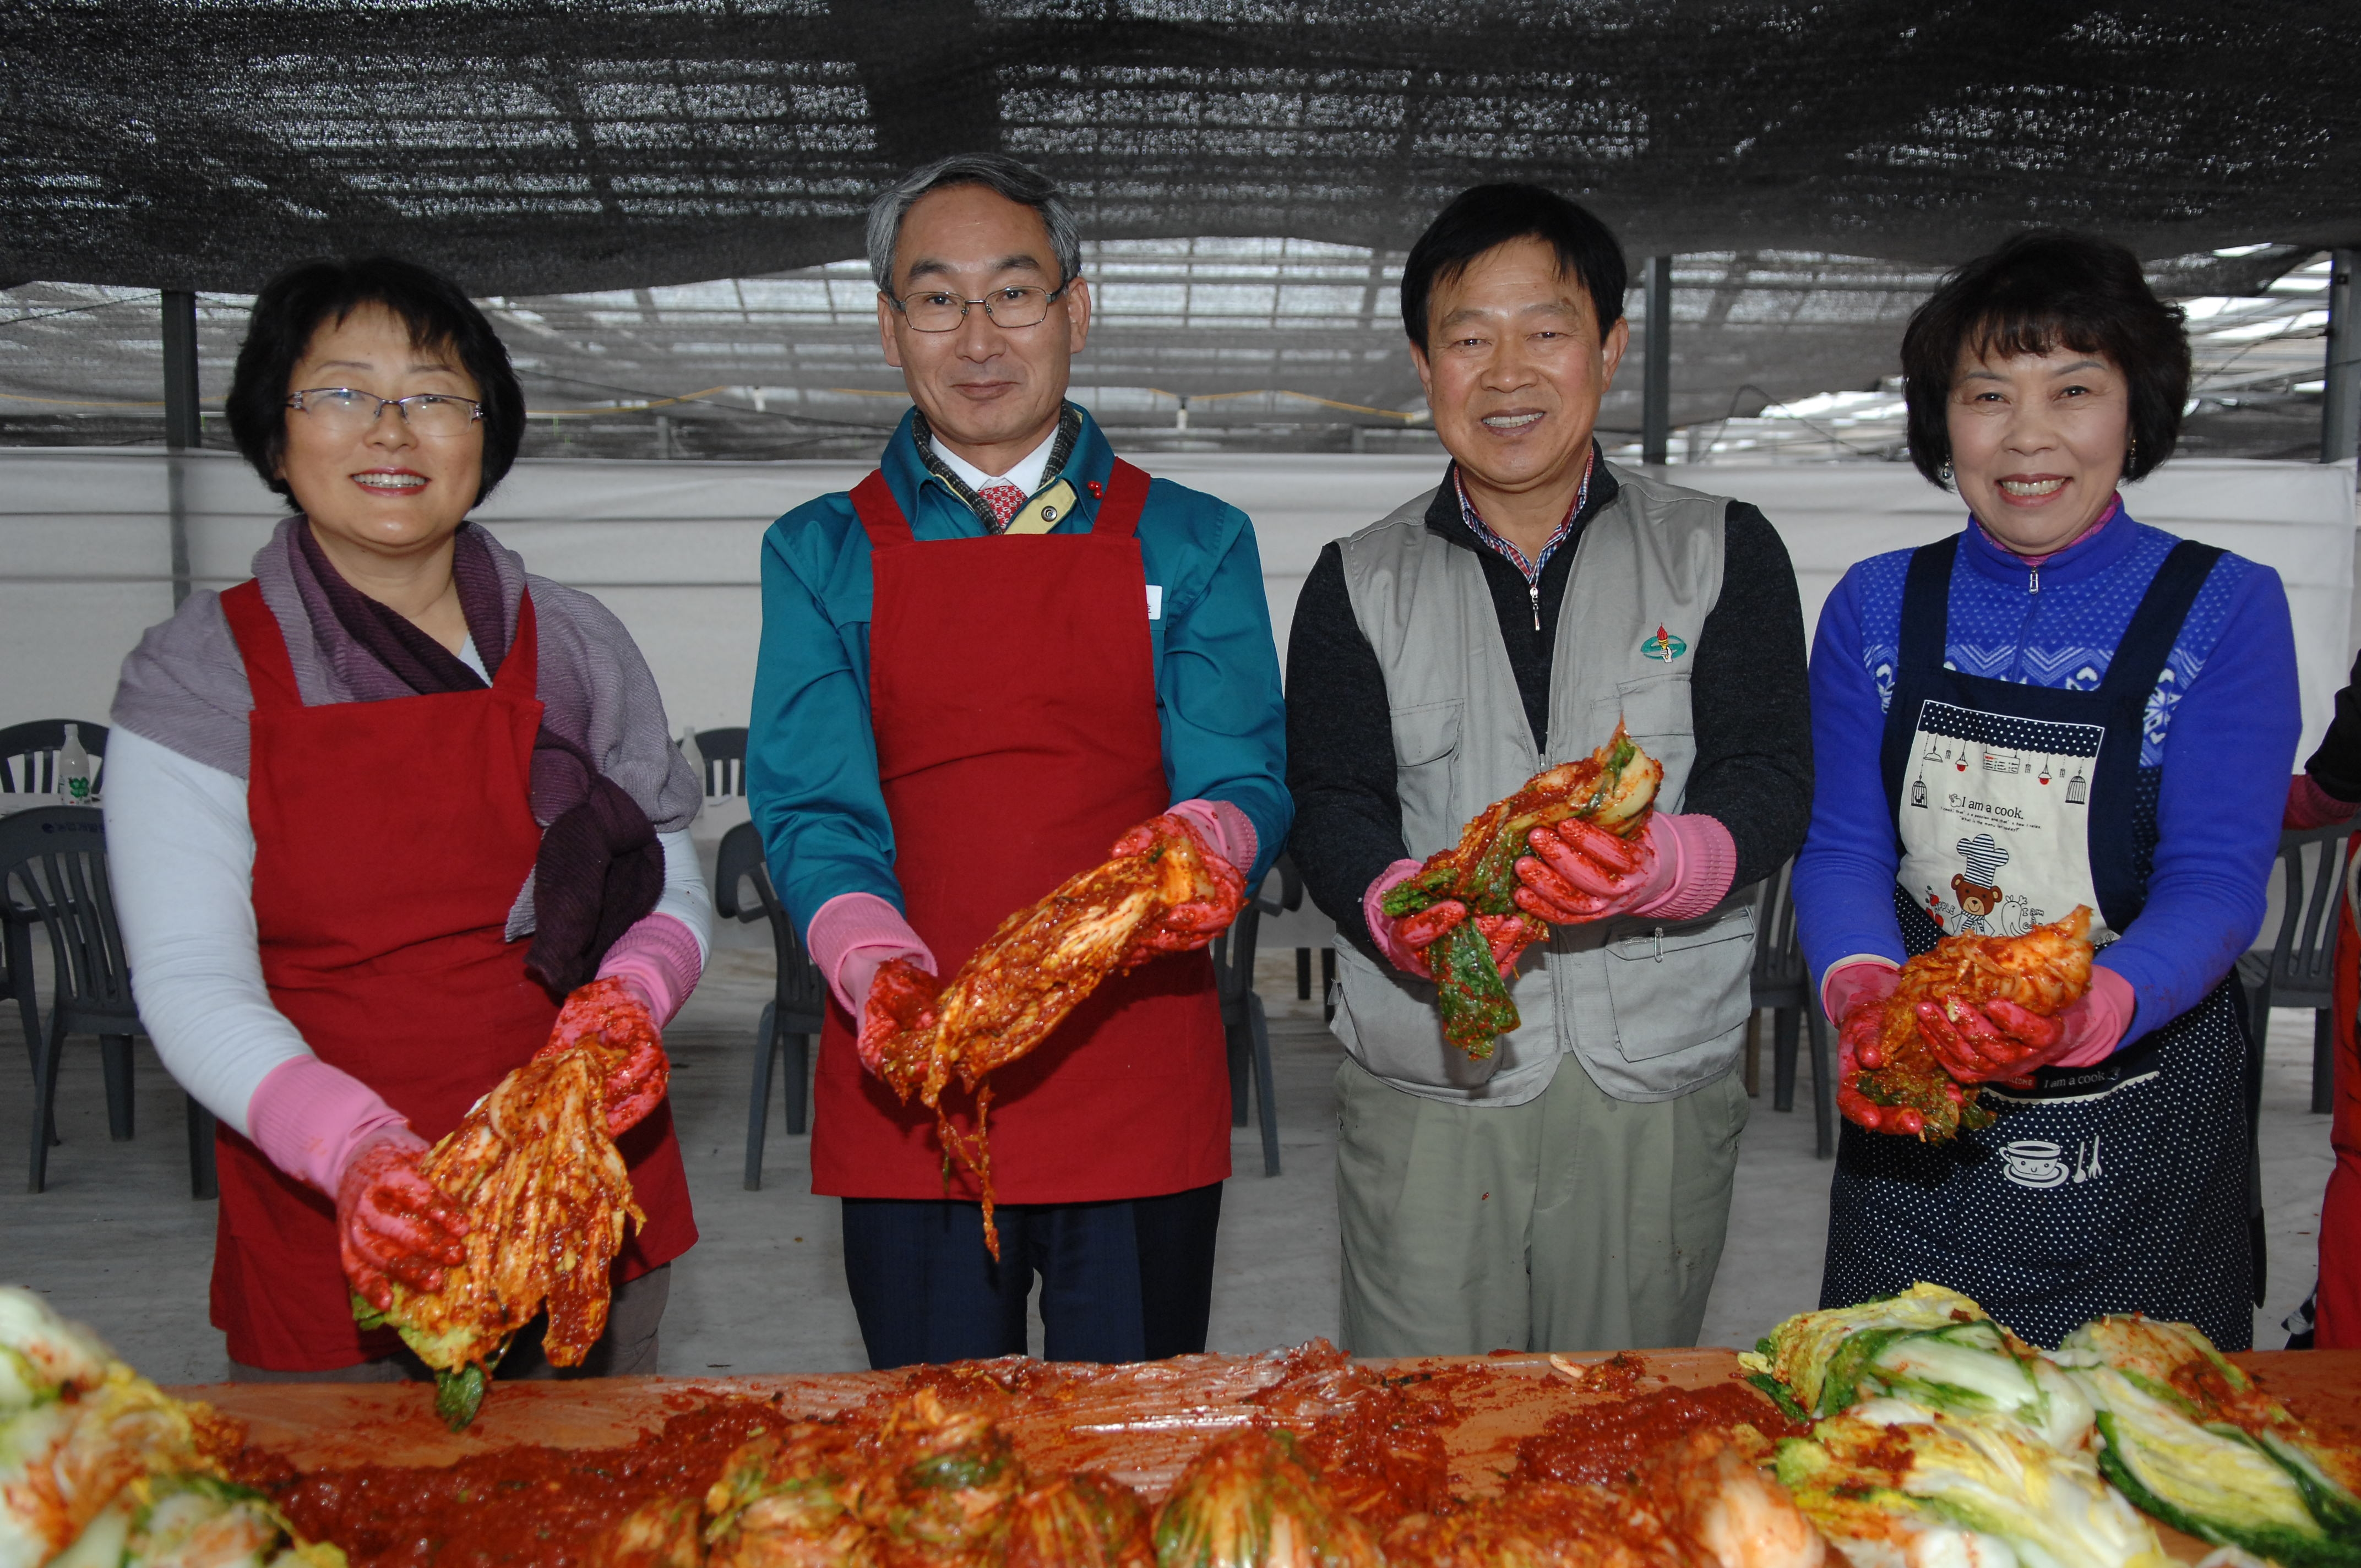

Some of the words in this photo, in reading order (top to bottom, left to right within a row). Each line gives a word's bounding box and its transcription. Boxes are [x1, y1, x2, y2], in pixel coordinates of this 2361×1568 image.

[1961, 797, 1966, 807] I
[1968, 800, 1983, 811] am
[1985, 804, 1992, 813] a
[1995, 807, 2023, 820] cook.
[1935, 901, 1955, 915] APPLE
[2022, 907, 2028, 916] I
[2030, 908, 2044, 916] am
[2044, 1080, 2049, 1088] I
[2050, 1079, 2066, 1088] am
[2069, 1077, 2075, 1086] a
[2077, 1071, 2105, 1084] cook
